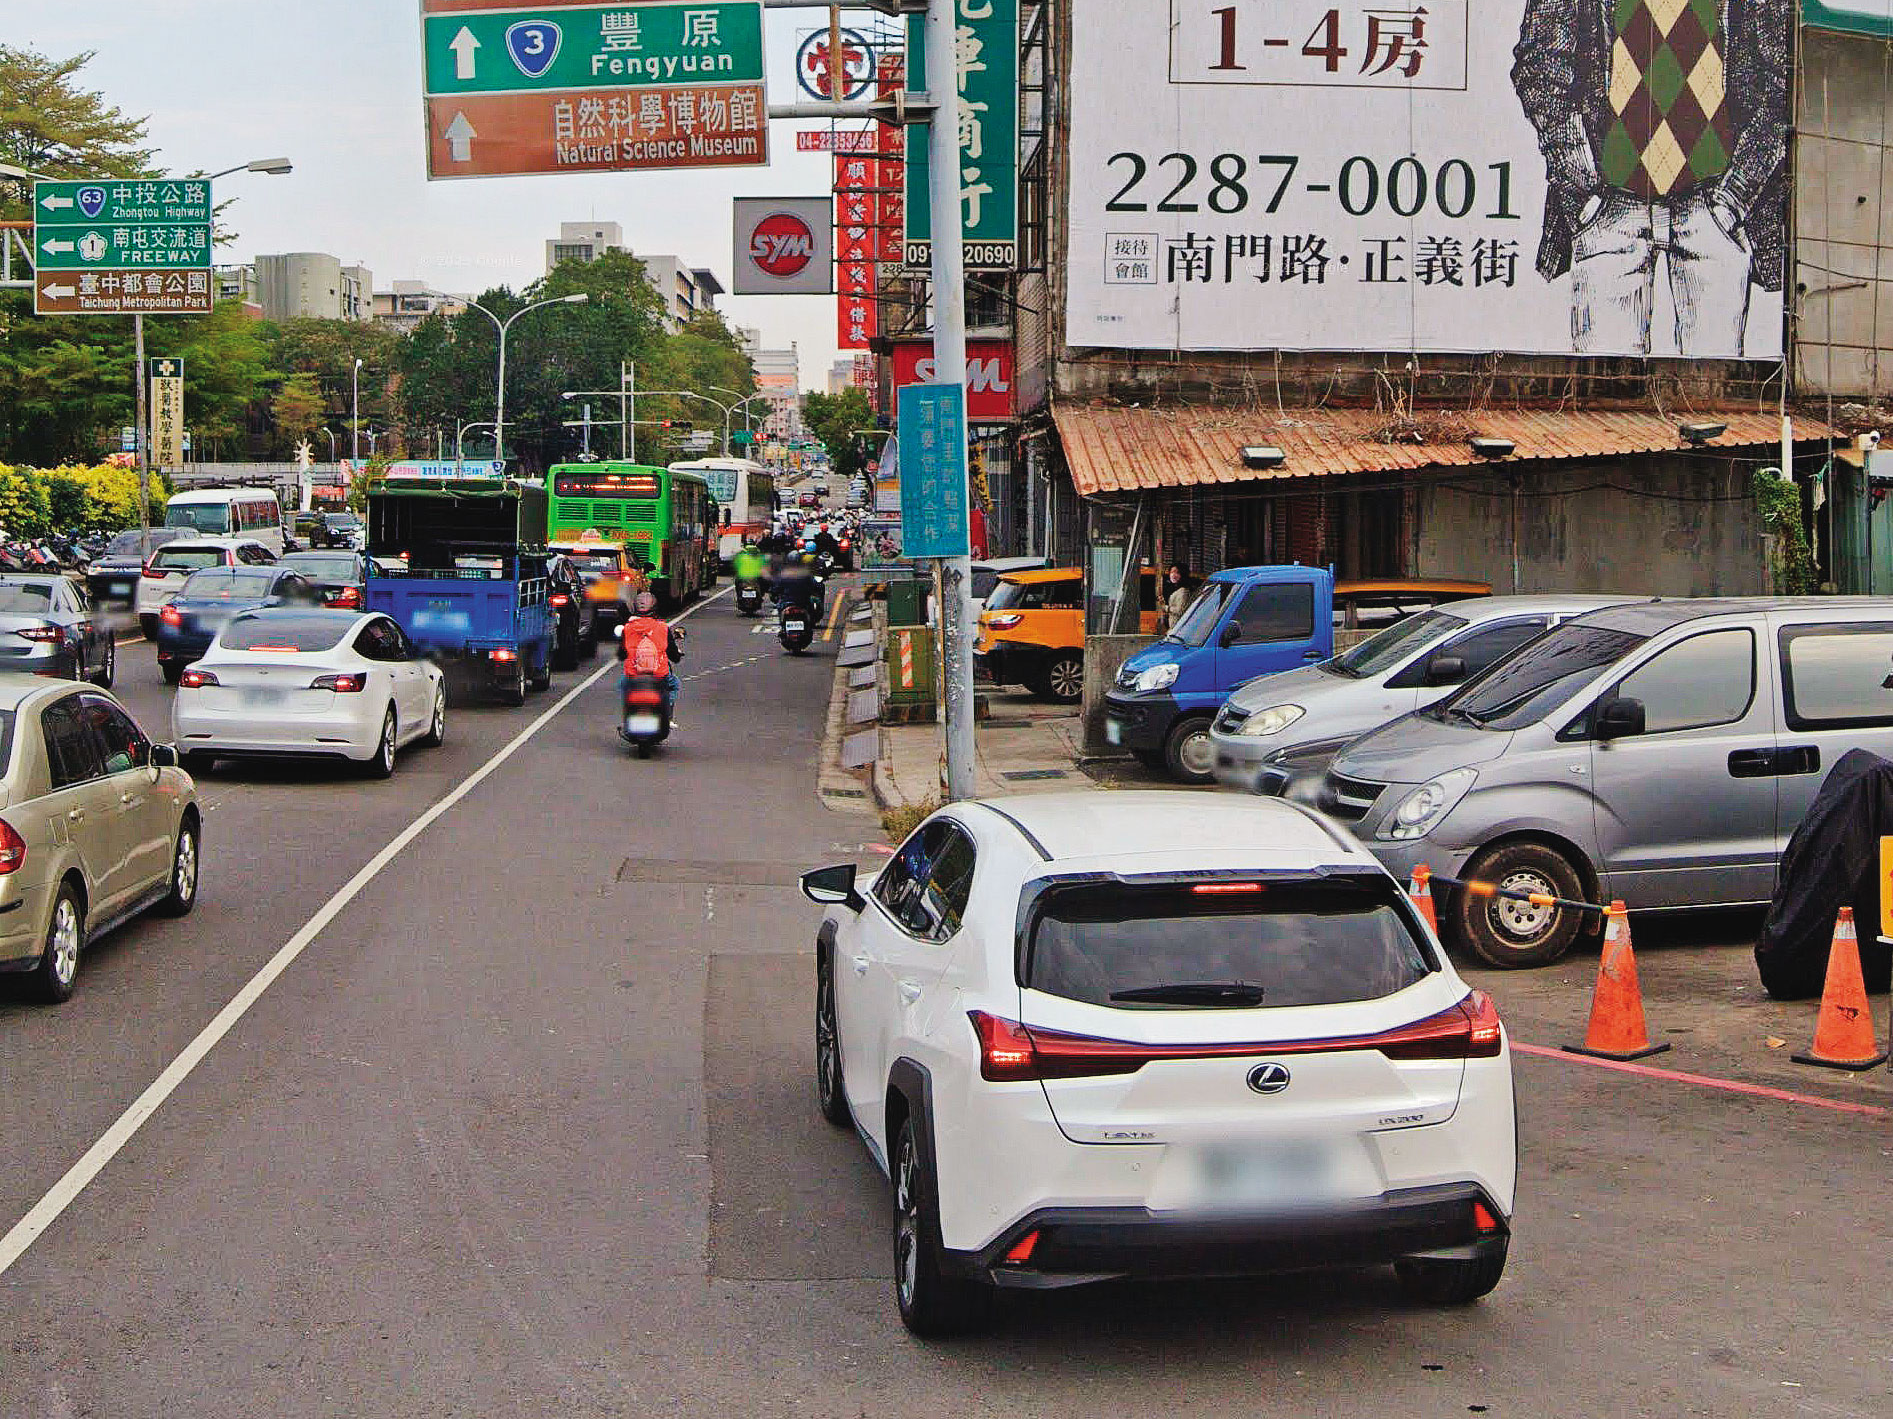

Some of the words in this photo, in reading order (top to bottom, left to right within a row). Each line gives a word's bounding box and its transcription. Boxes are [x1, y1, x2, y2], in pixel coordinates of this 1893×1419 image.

[523, 29, 544, 54] 3
[599, 9, 722, 54] 豐原
[1208, 4, 1430, 78] 1-4房
[591, 52, 734, 80] Fengyuan
[554, 90, 758, 141] 自然科學博物館
[557, 138, 619, 165] Natural
[622, 136, 686, 162] Science
[690, 133, 758, 157] Museum
[82, 192, 102, 204] 63
[112, 182, 207, 205] 中投公路
[1104, 152, 1521, 220] 2287-0001
[112, 207, 159, 220] Zhongtou
[165, 206, 206, 220] Highway
[113, 228, 207, 249] 南屯交流道
[751, 234, 813, 263] SYM
[1113, 239, 1149, 257] 接待
[121, 250, 201, 263] FREEWAY
[79, 272, 208, 294] 臺中都會公園
[1113, 262, 1149, 281] 會館
[79, 297, 120, 310] Taichung
[122, 296, 182, 310] Metropolitan
[184, 296, 207, 308] Park
[915, 357, 1010, 393] SM
